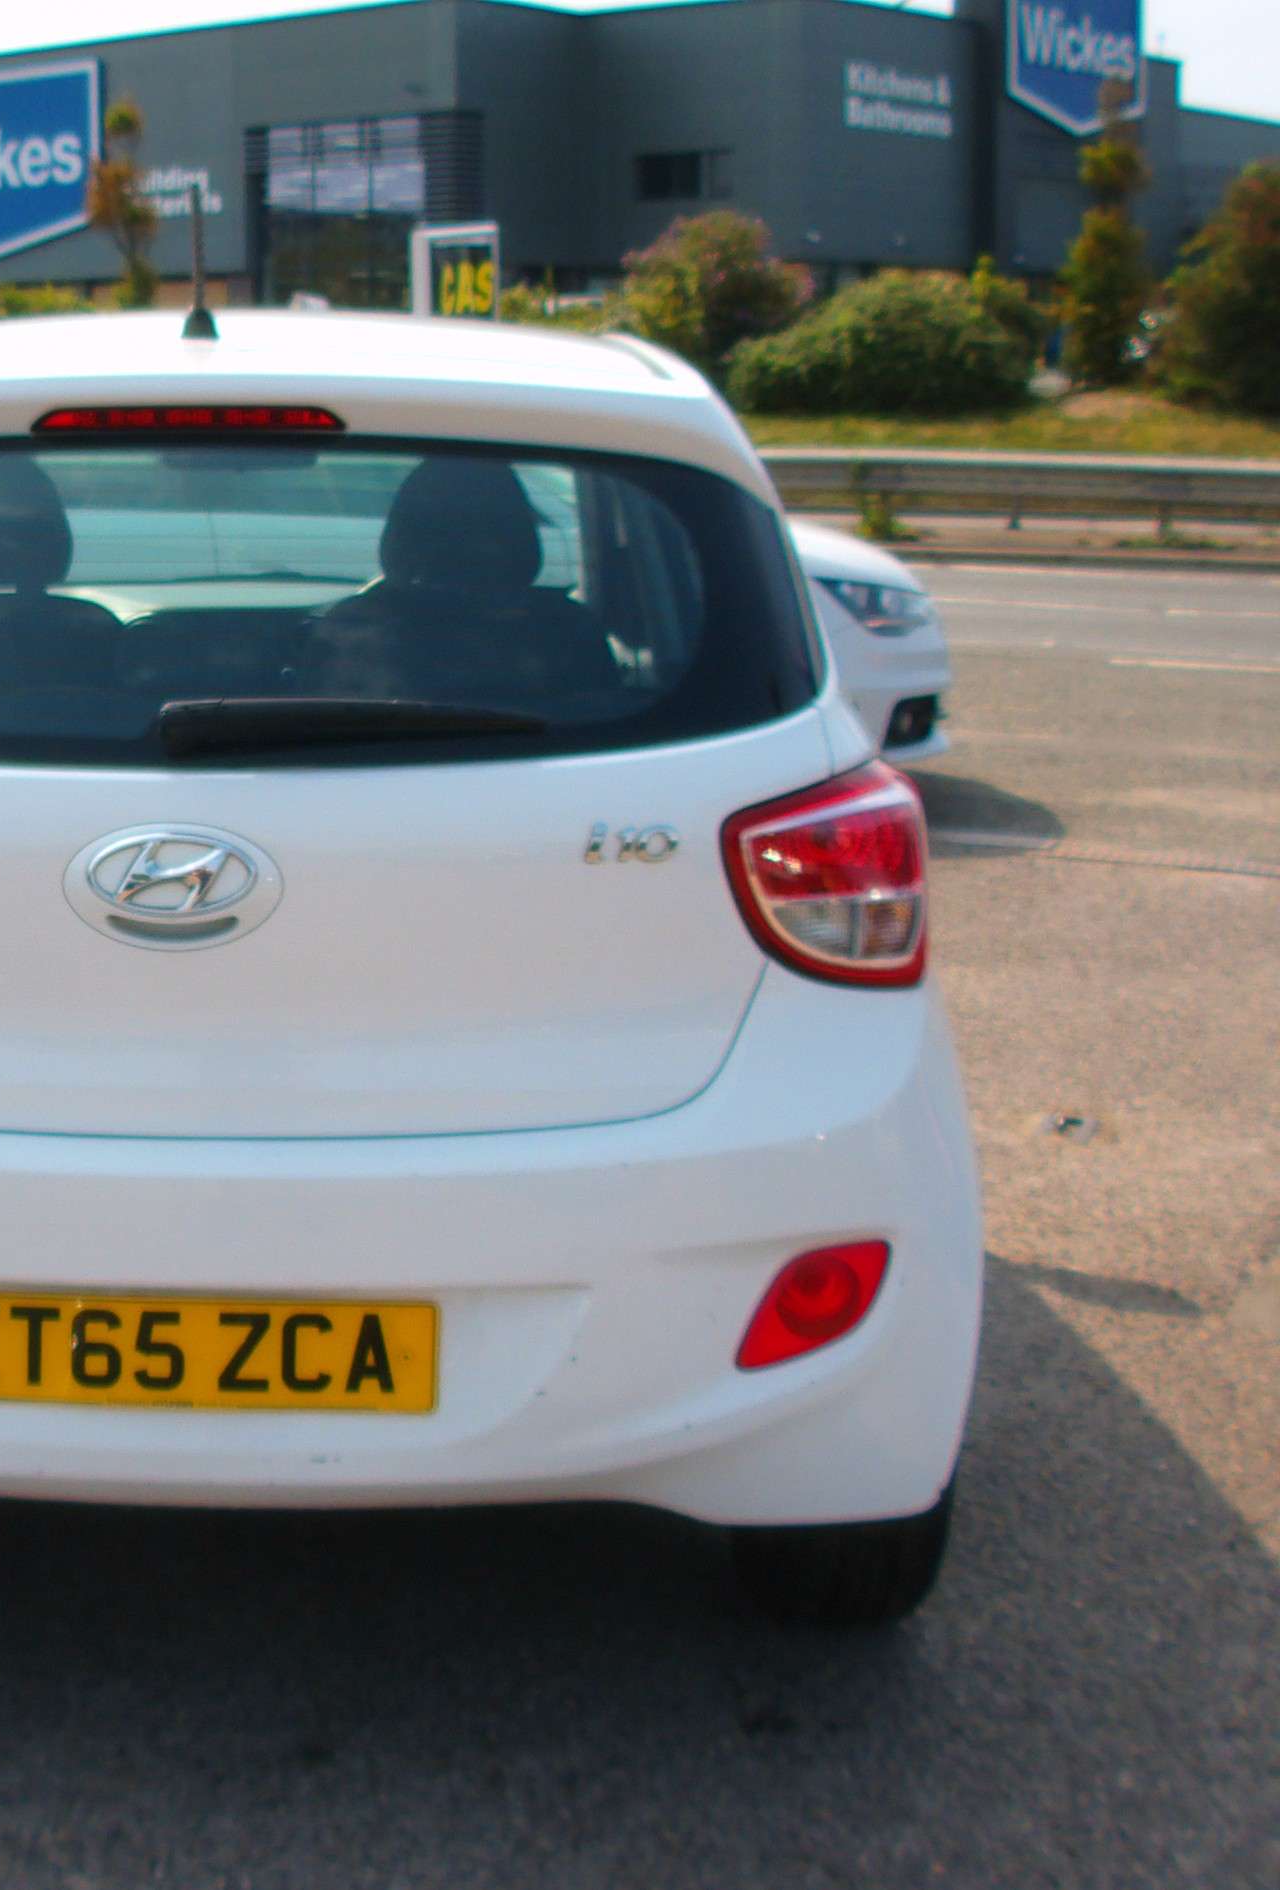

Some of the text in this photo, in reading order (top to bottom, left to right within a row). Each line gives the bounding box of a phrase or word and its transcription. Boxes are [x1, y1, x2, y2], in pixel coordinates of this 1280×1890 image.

[1021, 3, 1136, 80] Wickes
[846, 63, 934, 102] Kitchens
[846, 96, 954, 136] Bathrooms
[217, 1313, 396, 1394] ZCA
